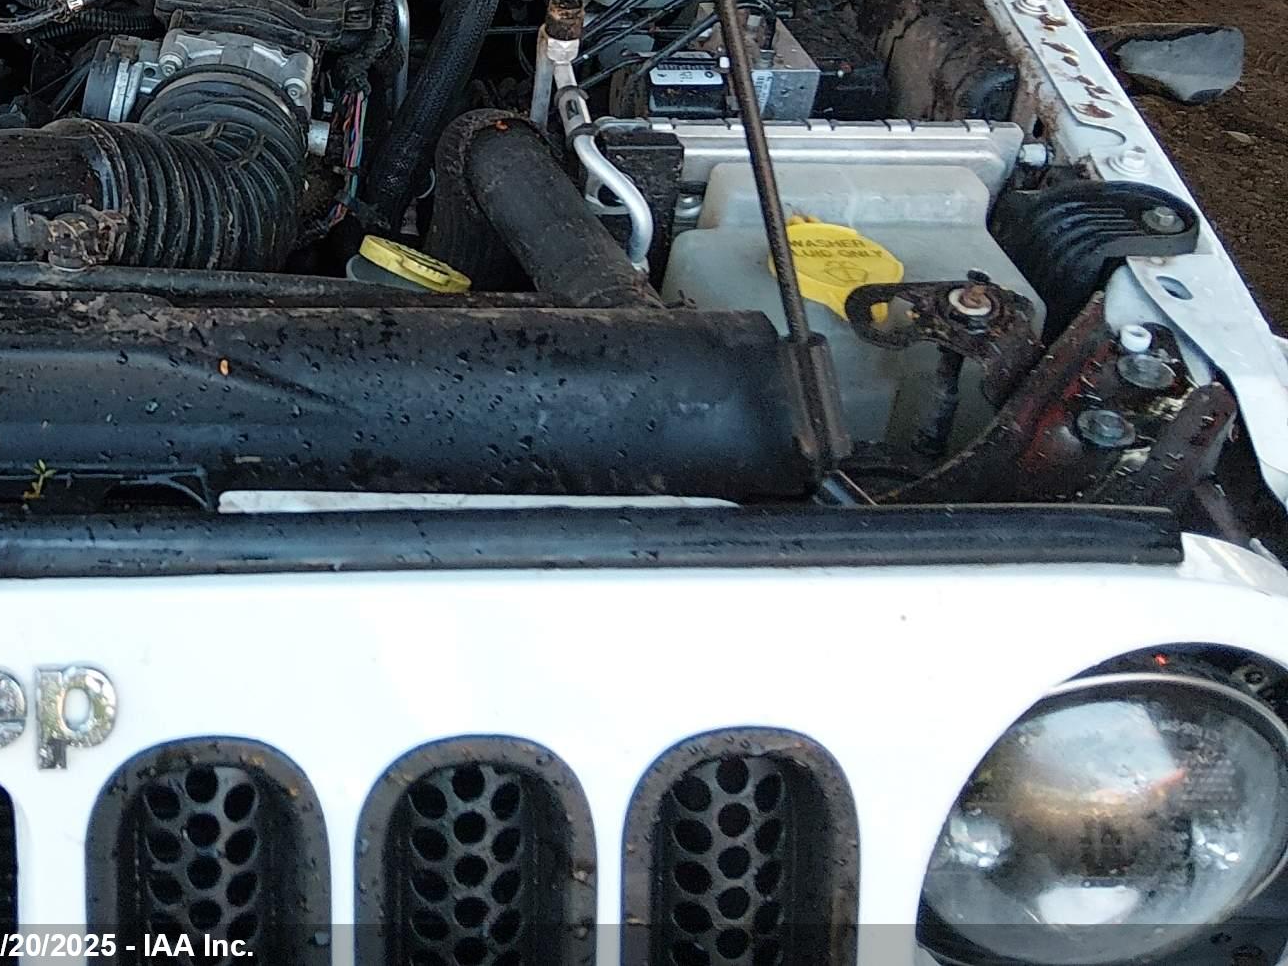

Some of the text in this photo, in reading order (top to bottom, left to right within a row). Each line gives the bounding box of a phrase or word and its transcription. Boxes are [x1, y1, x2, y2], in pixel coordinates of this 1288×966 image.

[789, 239, 866, 248] WASHER
[791, 249, 882, 258] LUID ONLY
